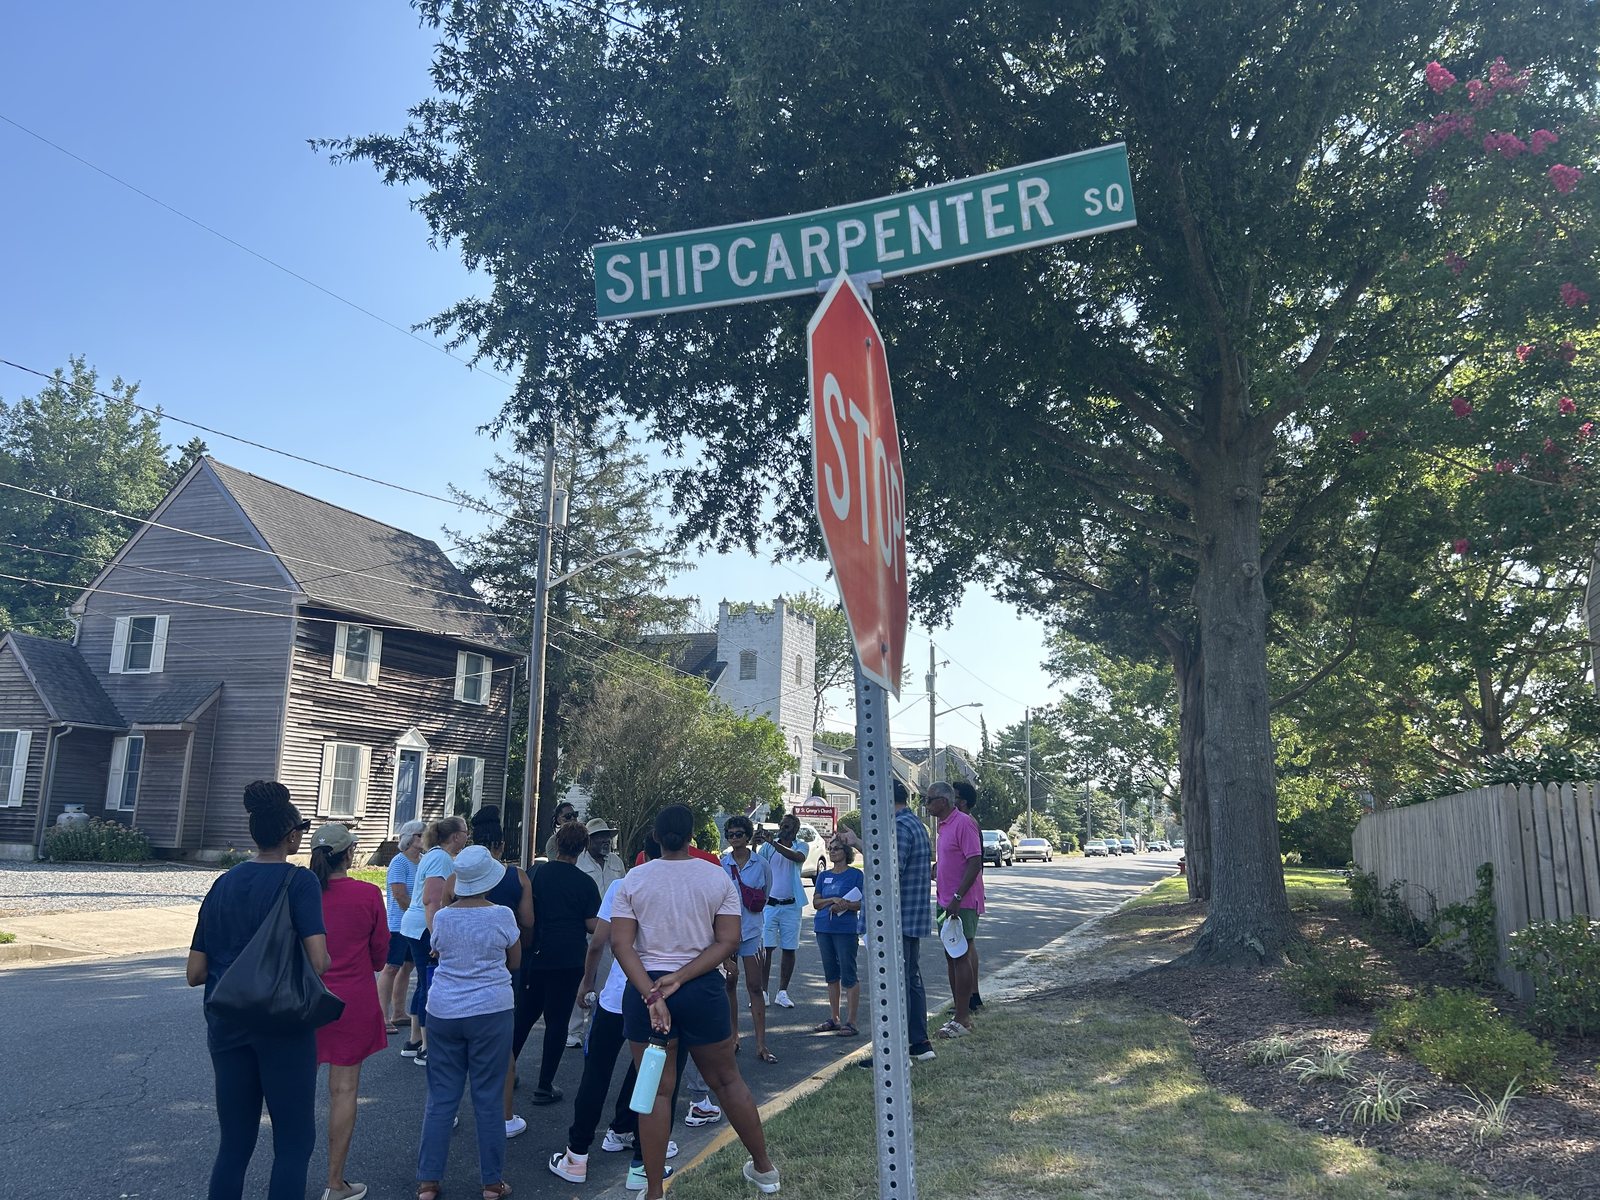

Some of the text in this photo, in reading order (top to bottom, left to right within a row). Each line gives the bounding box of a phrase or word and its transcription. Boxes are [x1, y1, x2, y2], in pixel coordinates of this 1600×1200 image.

[605, 177, 1125, 304] SHIPCARPENTER SQ
[822, 372, 902, 584] STOP
